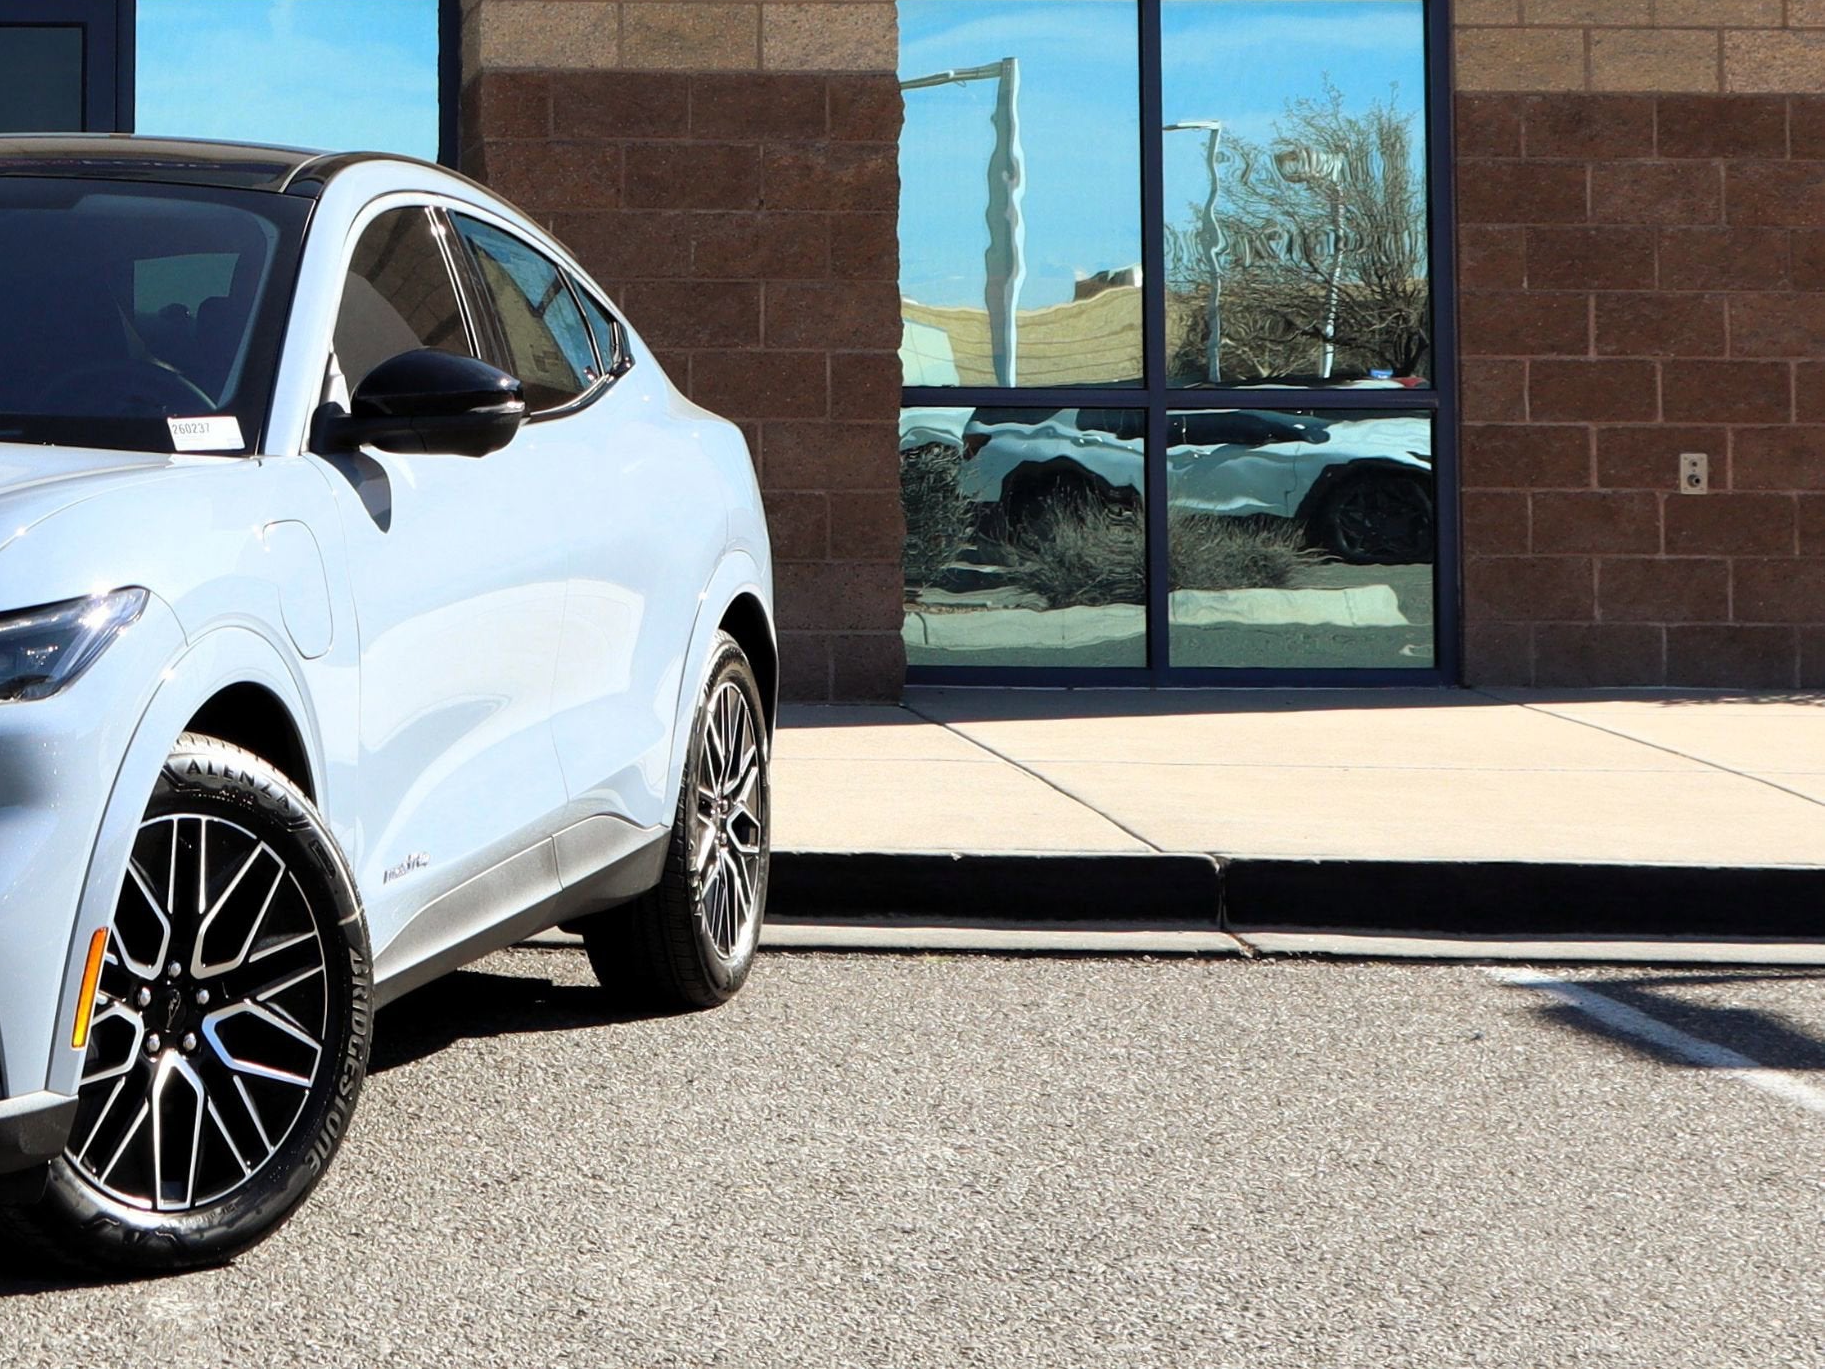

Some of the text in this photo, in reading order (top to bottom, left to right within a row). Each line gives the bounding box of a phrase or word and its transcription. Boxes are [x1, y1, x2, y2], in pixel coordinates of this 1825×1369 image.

[172, 423, 210, 434] 260237
[186, 758, 291, 812] ALENZA
[305, 947, 370, 1176] BRIDGESTONE
